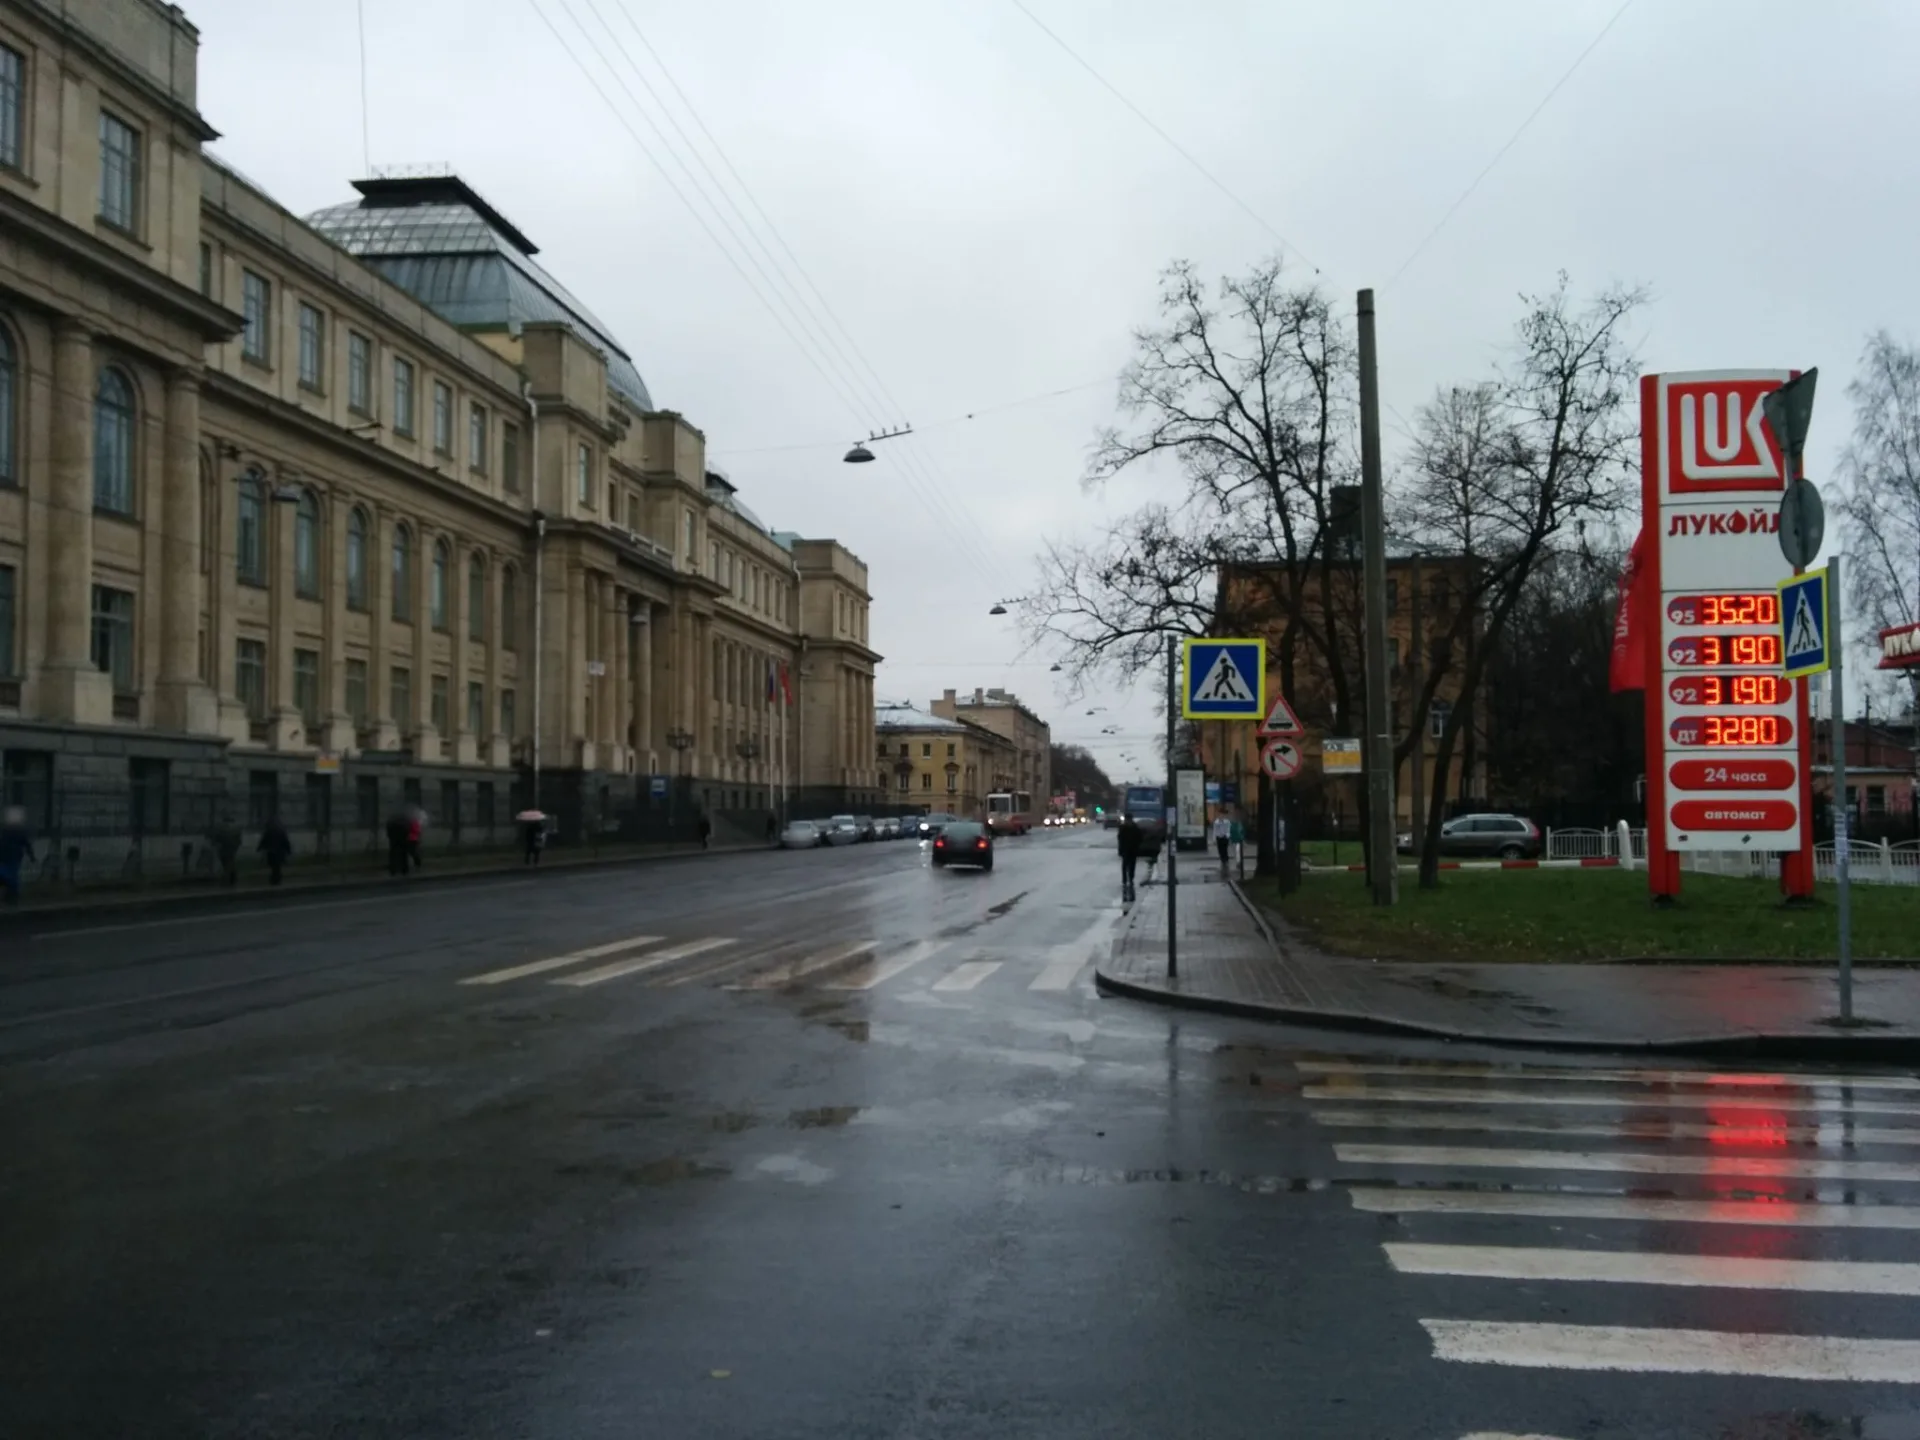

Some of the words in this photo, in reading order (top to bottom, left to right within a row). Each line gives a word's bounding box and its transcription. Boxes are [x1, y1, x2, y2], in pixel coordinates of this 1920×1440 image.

[1671, 610, 1696, 624] 95
[1671, 649, 1697, 663] 92
[1672, 688, 1697, 702] 92
[1677, 730, 1698, 744] ДТ
[1704, 767, 1728, 783] 24
[1731, 773, 1767, 783] часа
[1704, 811, 1766, 821] автомат
